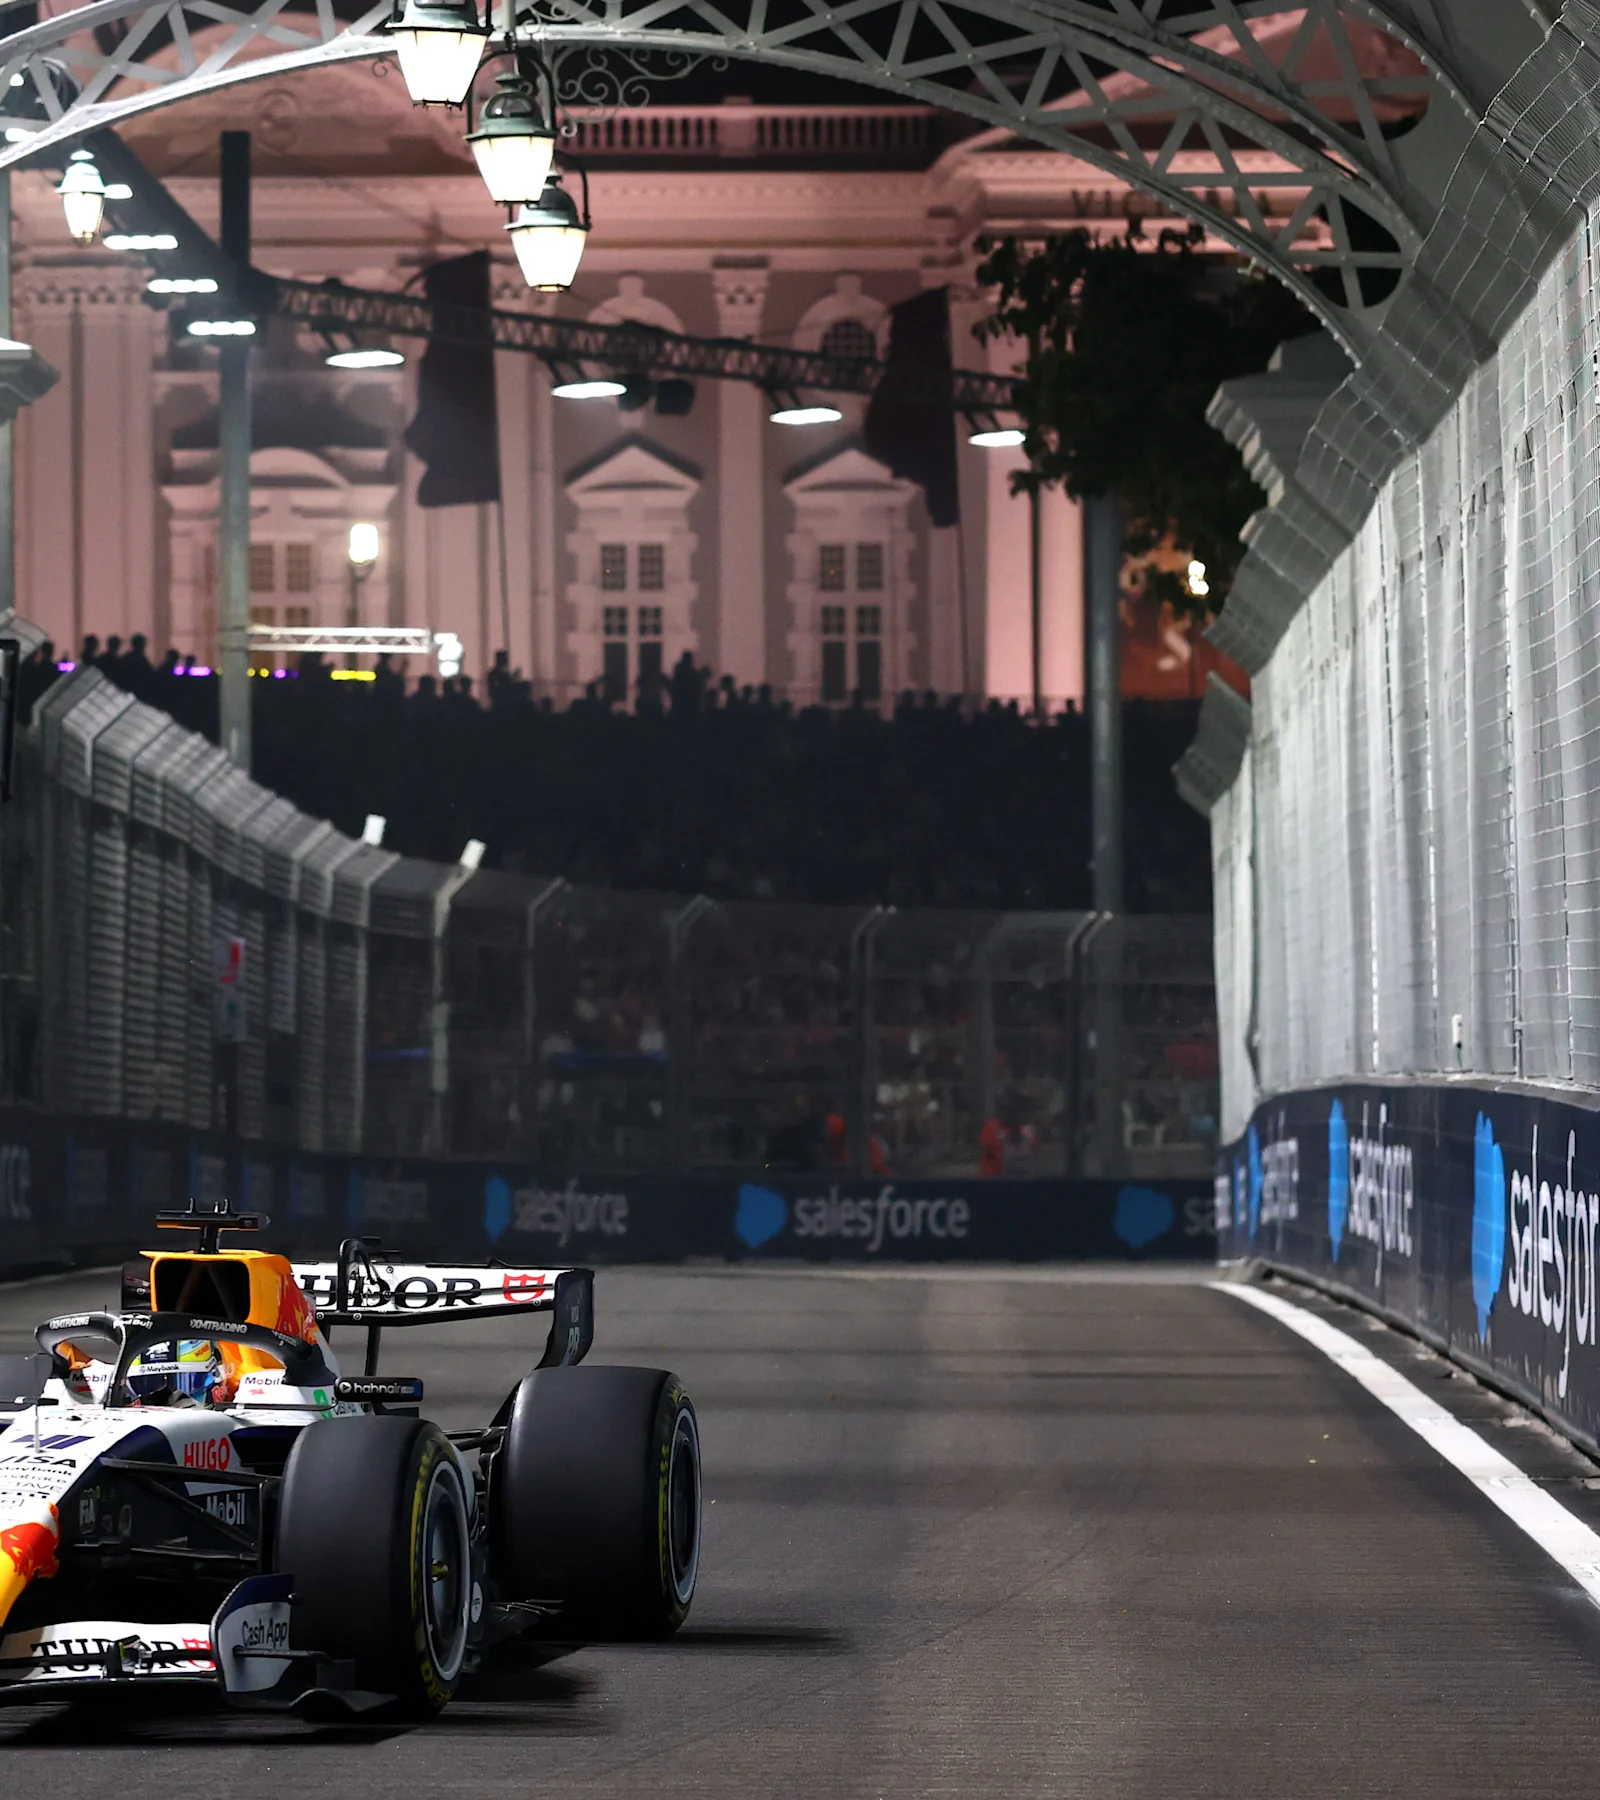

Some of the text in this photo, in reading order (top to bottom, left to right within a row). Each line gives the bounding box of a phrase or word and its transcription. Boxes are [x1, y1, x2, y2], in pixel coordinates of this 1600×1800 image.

[793, 1184, 972, 1252] salesforce
[293, 1275, 483, 1309] UDOR
[71, 1373, 107, 1384] Mobil
[243, 1376, 281, 1386] Mobil
[353, 1382, 402, 1395] hahnair
[183, 1436, 231, 1472] HUGO
[206, 1493, 246, 1526] Mobil
[242, 1617, 288, 1648] Cash App
[30, 1638, 187, 1675] TUDR
